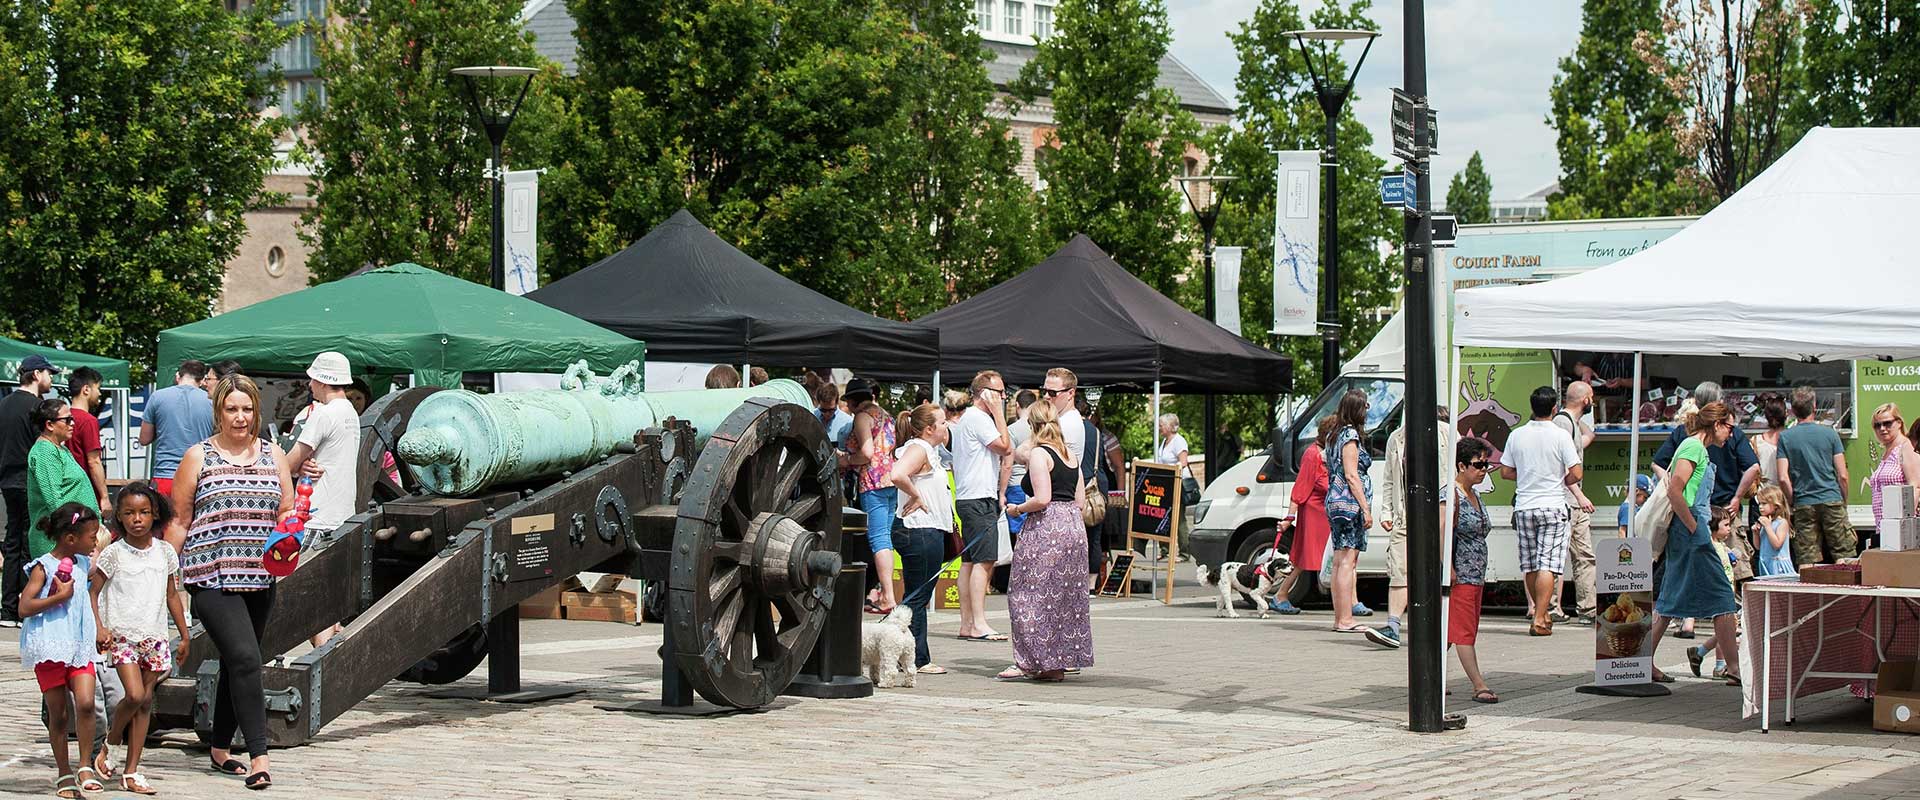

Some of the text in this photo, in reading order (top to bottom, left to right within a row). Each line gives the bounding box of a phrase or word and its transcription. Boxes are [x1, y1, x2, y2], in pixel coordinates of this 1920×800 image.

[1586, 241, 1638, 257] From our
[1453, 254, 1541, 269] COURT FARM
[1862, 366, 1885, 376] Tel:
[1145, 495, 1160, 506] FREE
[1139, 504, 1166, 518] KETCHUP
[1608, 582, 1644, 591] Gluten Free
[1611, 660, 1640, 669] Delicious
[1604, 670, 1646, 681] Cheesebreads
